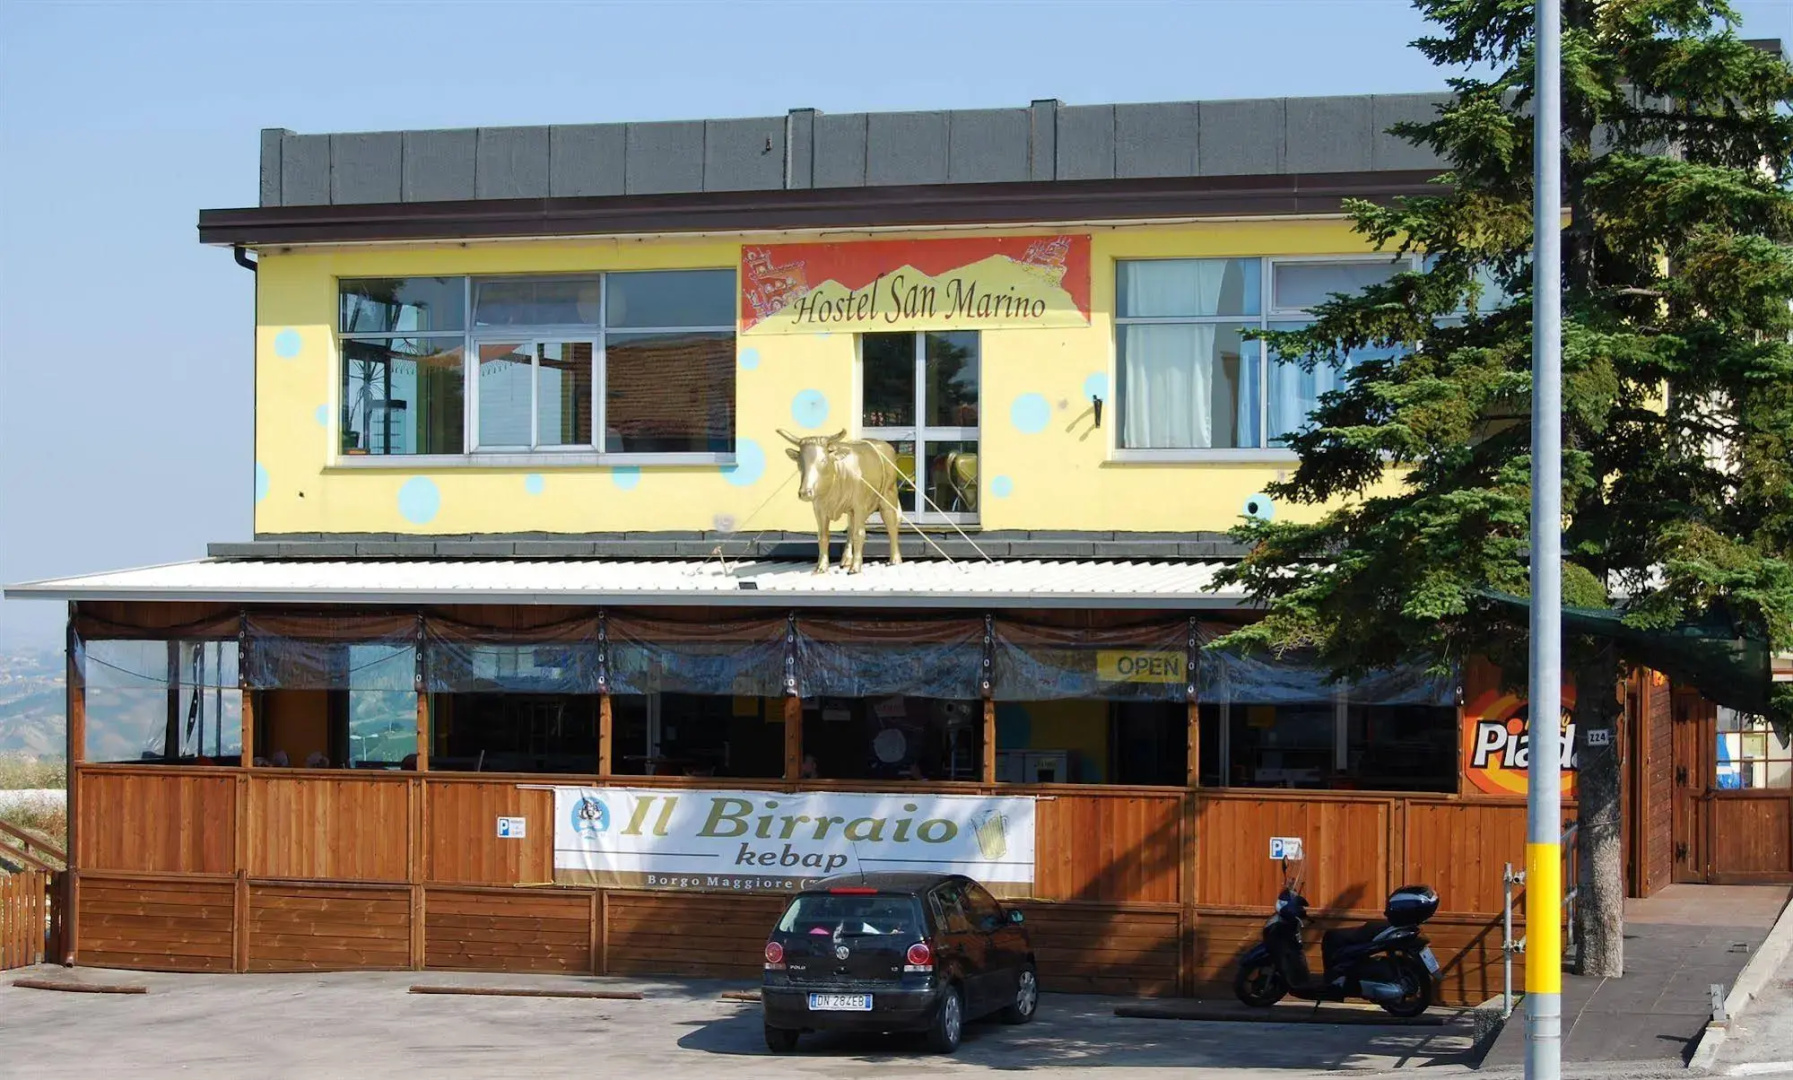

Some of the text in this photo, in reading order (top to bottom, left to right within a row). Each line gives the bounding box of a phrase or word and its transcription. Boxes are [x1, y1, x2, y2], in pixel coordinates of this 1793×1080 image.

[791, 273, 1046, 325] Hostel San Marino
[1118, 656, 1178, 675] OPEN
[620, 796, 958, 844] Il Birraio
[735, 842, 848, 873] kebap
[648, 874, 700, 887] Borgo
[707, 876, 793, 889] Maggiore
[817, 995, 864, 1007] DN 284EB
